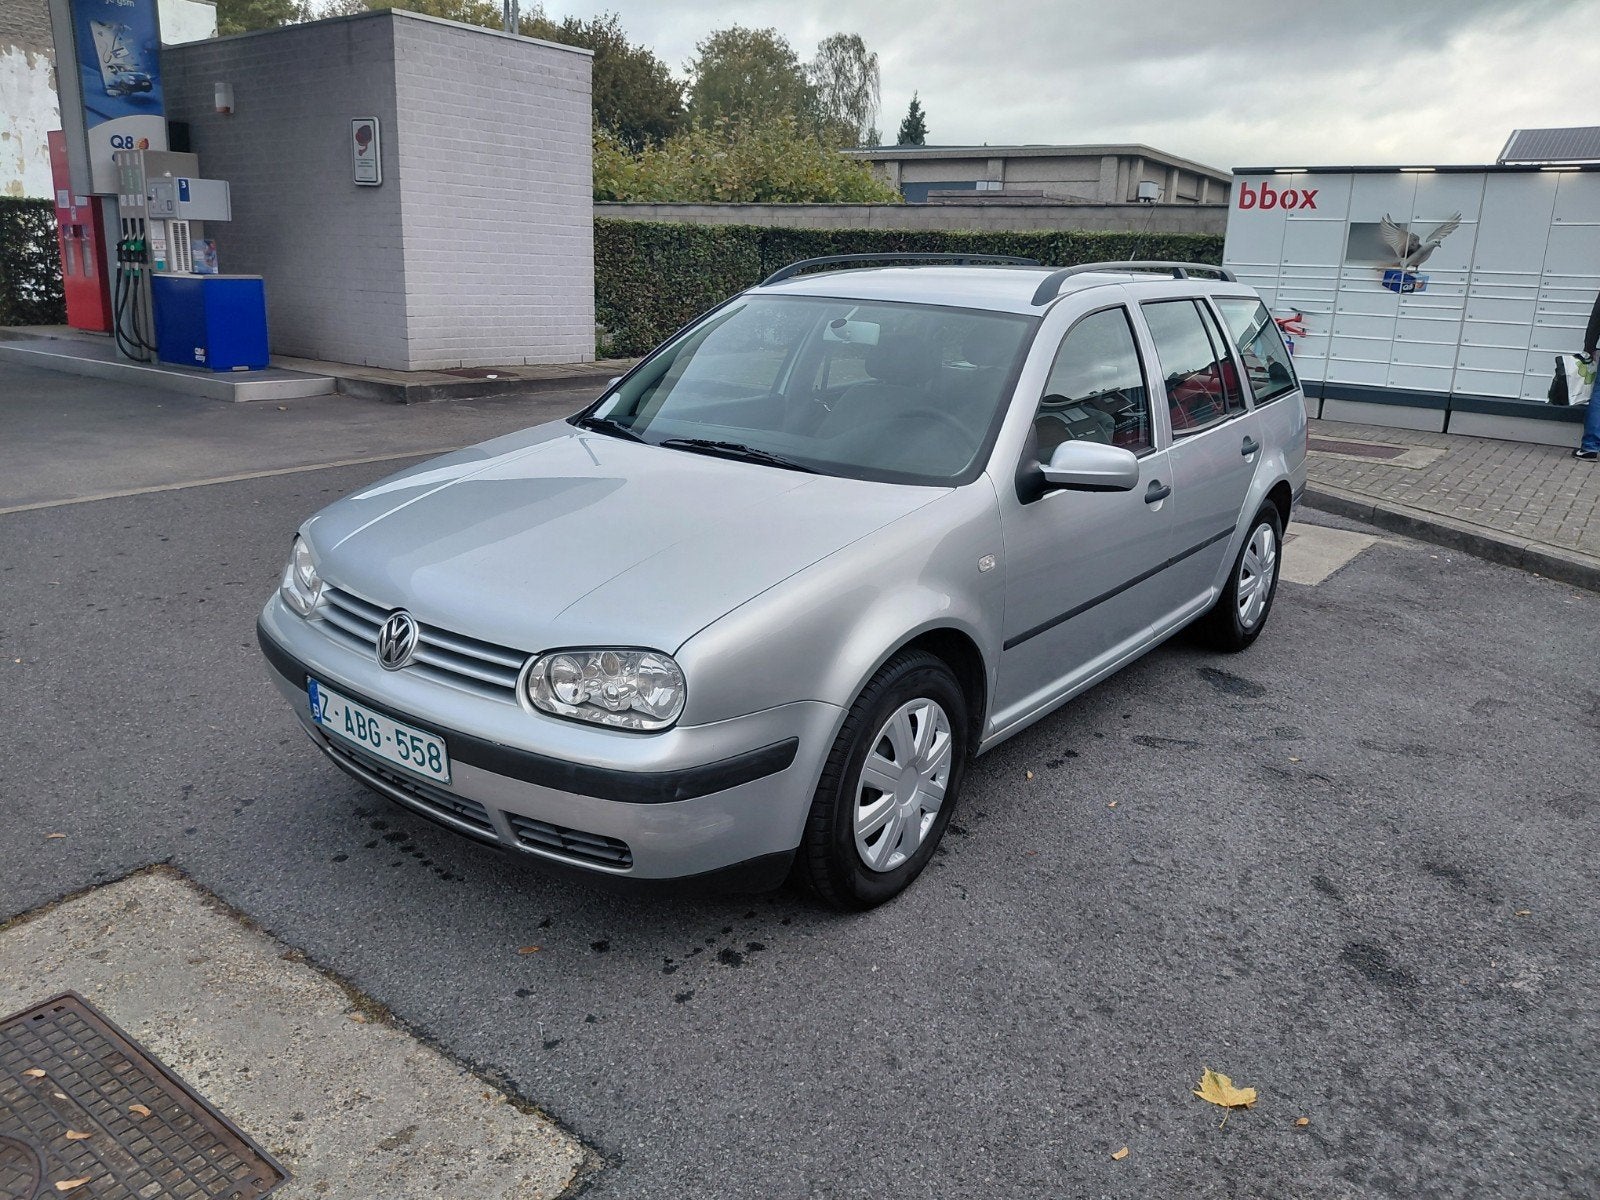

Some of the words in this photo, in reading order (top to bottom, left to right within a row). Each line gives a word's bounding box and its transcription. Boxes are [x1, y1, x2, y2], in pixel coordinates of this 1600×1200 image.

[110, 135, 134, 149] Q8
[1239, 182, 1319, 209] bbox
[313, 704, 320, 717] B
